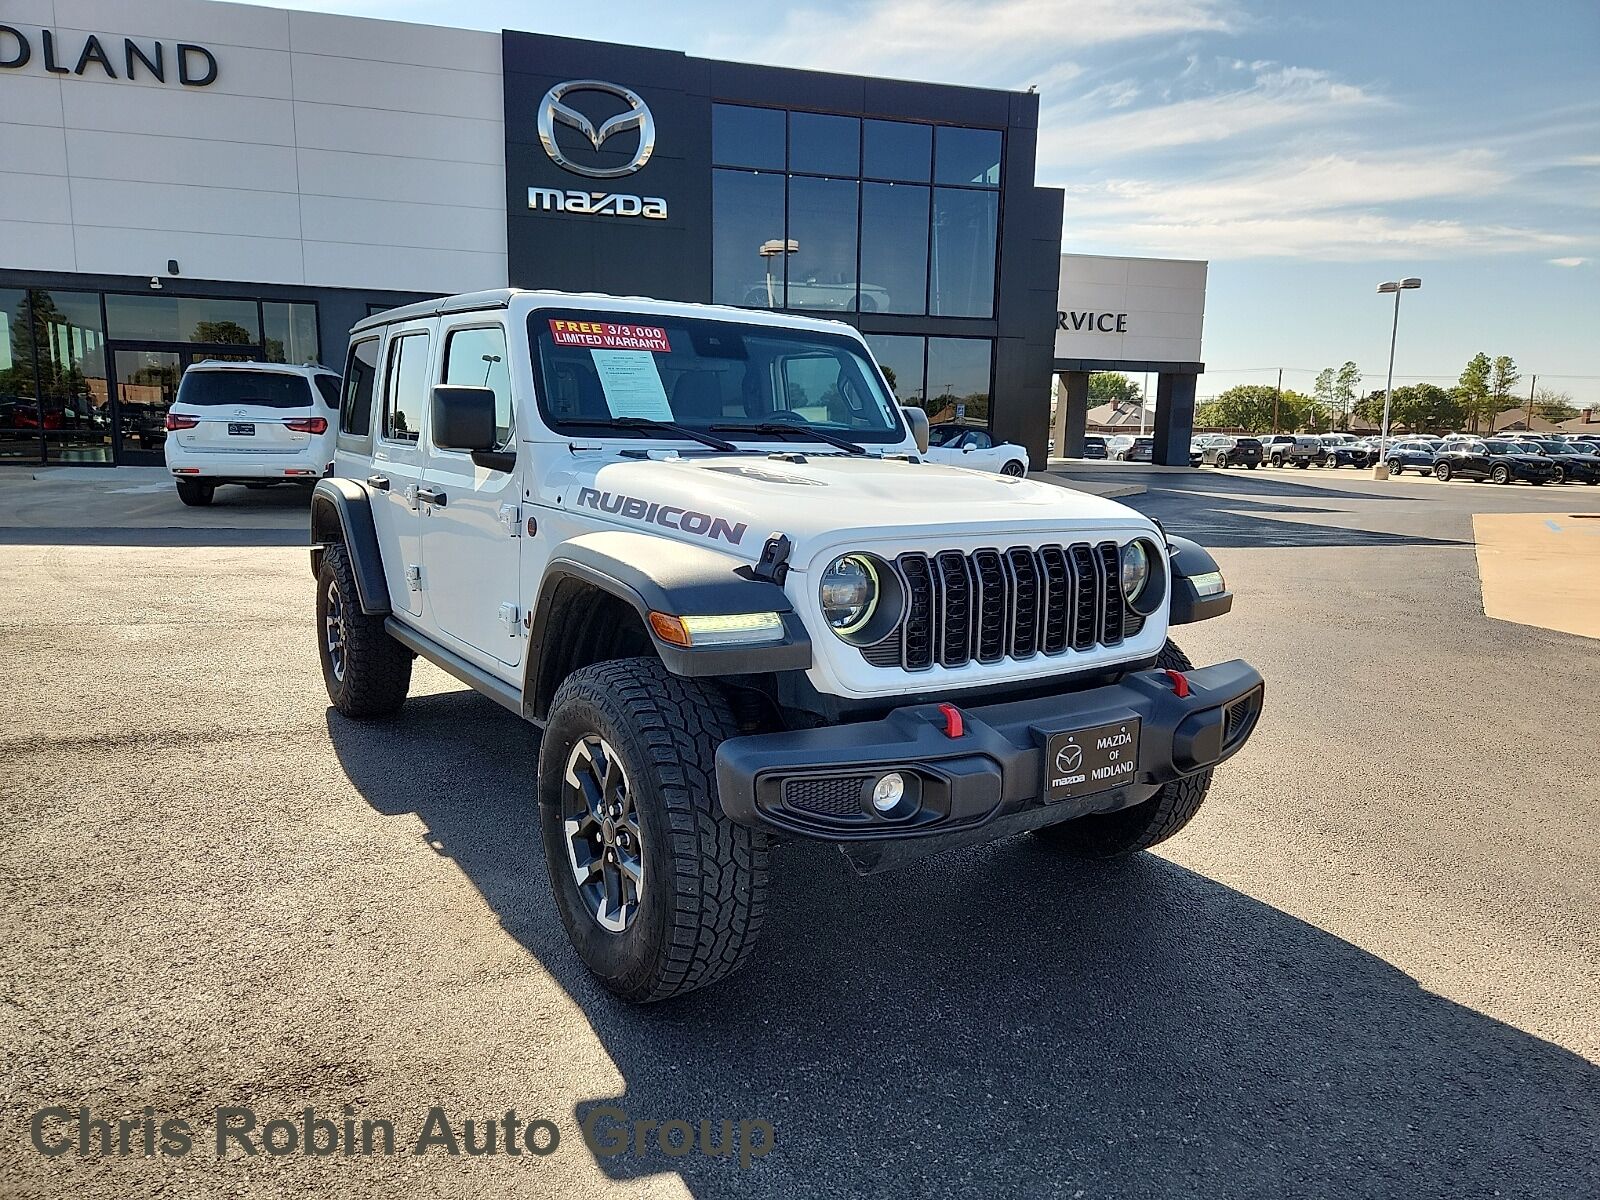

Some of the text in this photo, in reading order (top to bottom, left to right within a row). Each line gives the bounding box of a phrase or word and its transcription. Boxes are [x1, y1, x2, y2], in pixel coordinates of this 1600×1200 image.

[527, 186, 668, 220] mazda
[555, 321, 662, 338] FREE 3/3,000
[555, 332, 666, 350] LIMITED WARRANTY
[577, 486, 747, 546] RUBICON
[1096, 732, 1132, 750] MAZDA
[1109, 750, 1120, 761] OF
[1091, 760, 1134, 781] MIDLAND
[1052, 774, 1086, 787] mazda
